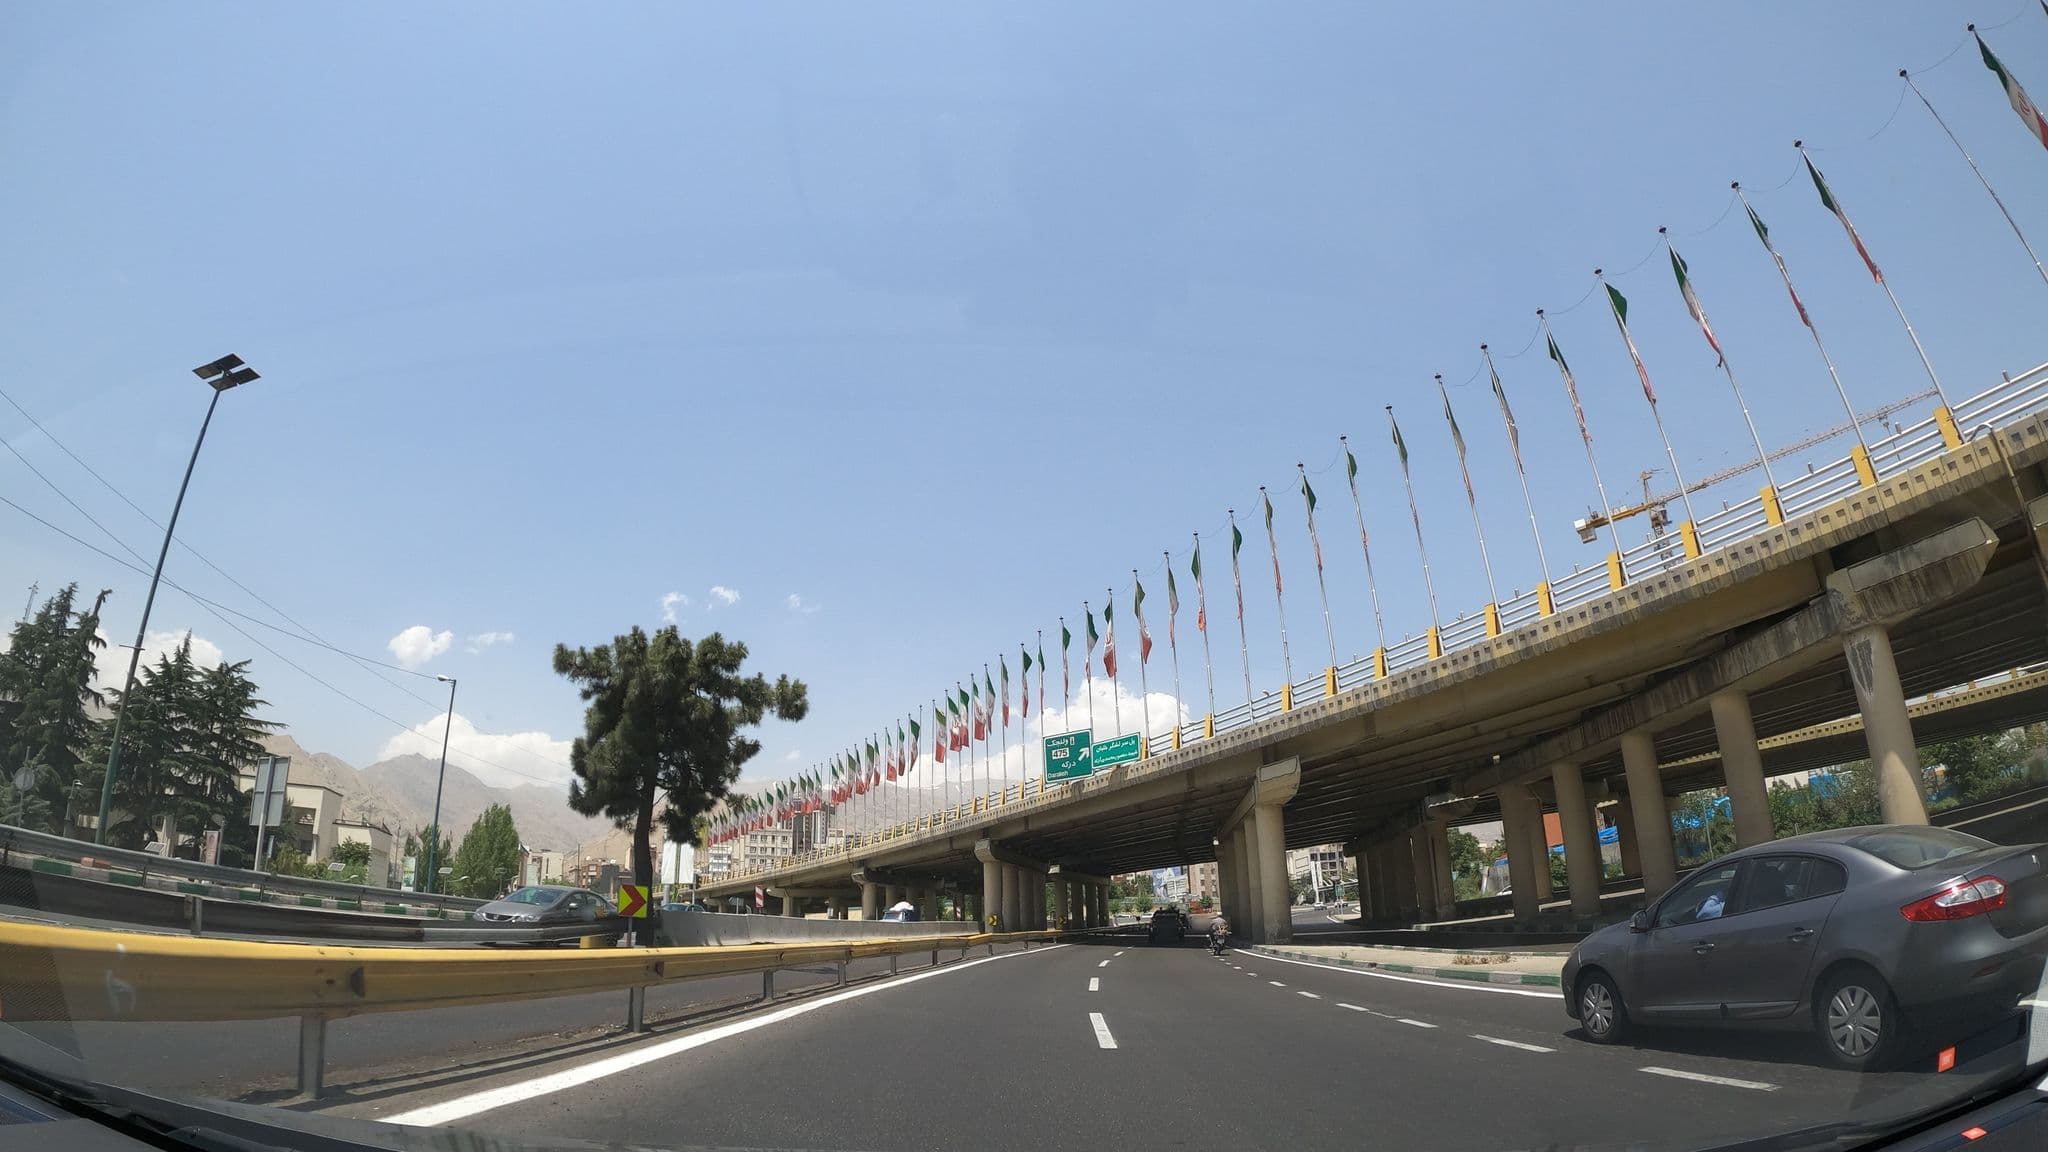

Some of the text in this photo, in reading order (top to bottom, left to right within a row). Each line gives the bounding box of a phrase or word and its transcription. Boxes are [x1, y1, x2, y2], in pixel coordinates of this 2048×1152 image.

[1047, 736, 1069, 747] ولنجک
[1053, 749, 1068, 758] 475
[1061, 760, 1077, 769] درکه
